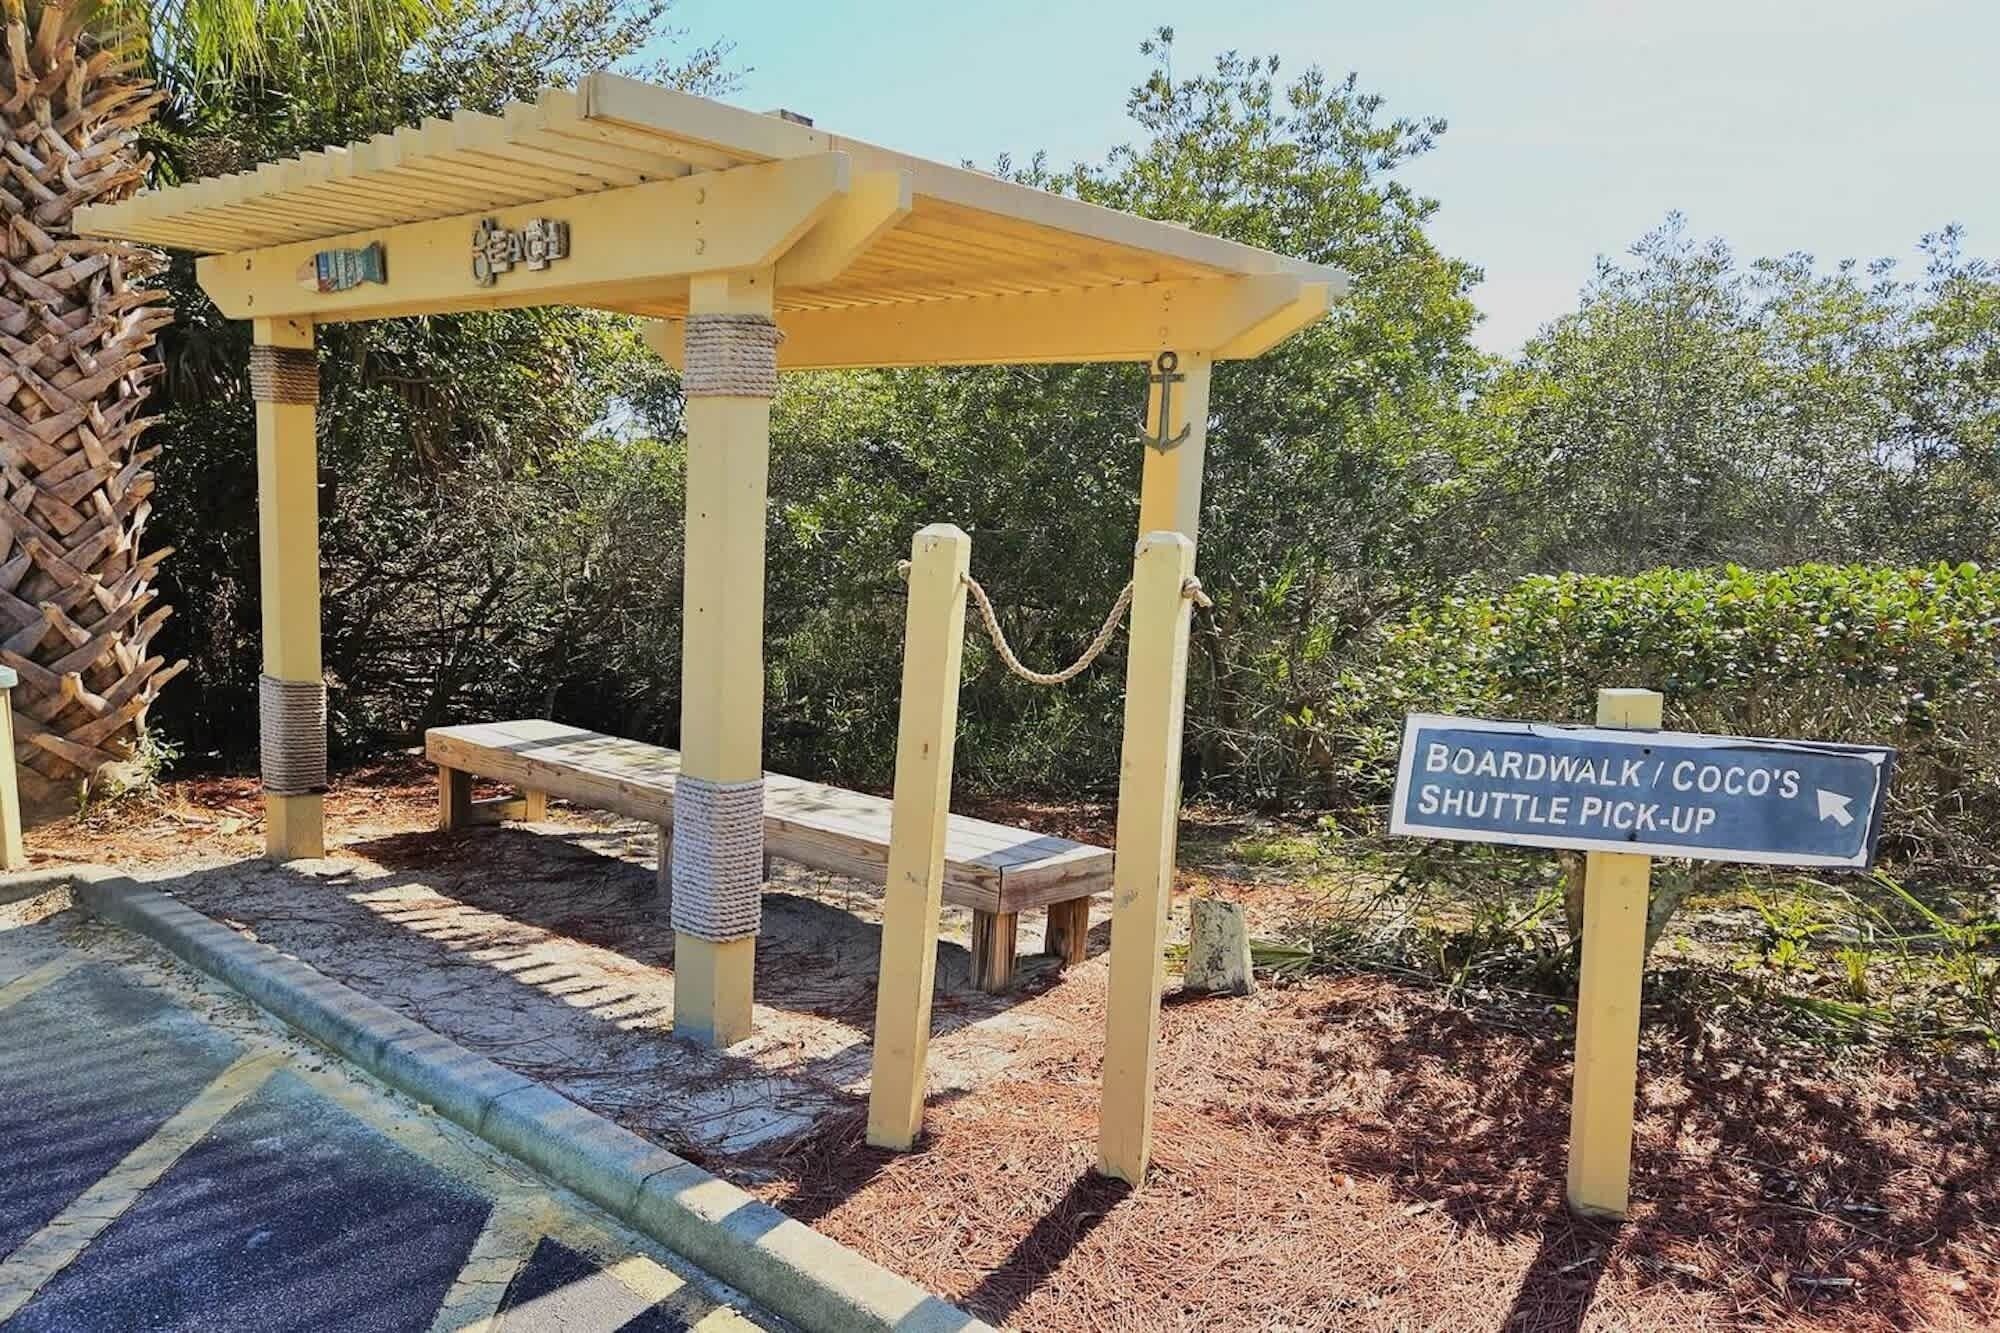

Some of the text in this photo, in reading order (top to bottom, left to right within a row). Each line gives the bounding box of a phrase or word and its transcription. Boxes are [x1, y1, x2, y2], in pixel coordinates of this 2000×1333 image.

[1425, 743, 1801, 799] BOARDWALK / COCO'S
[1418, 784, 1717, 834] SHUTTLE PICK-UP
